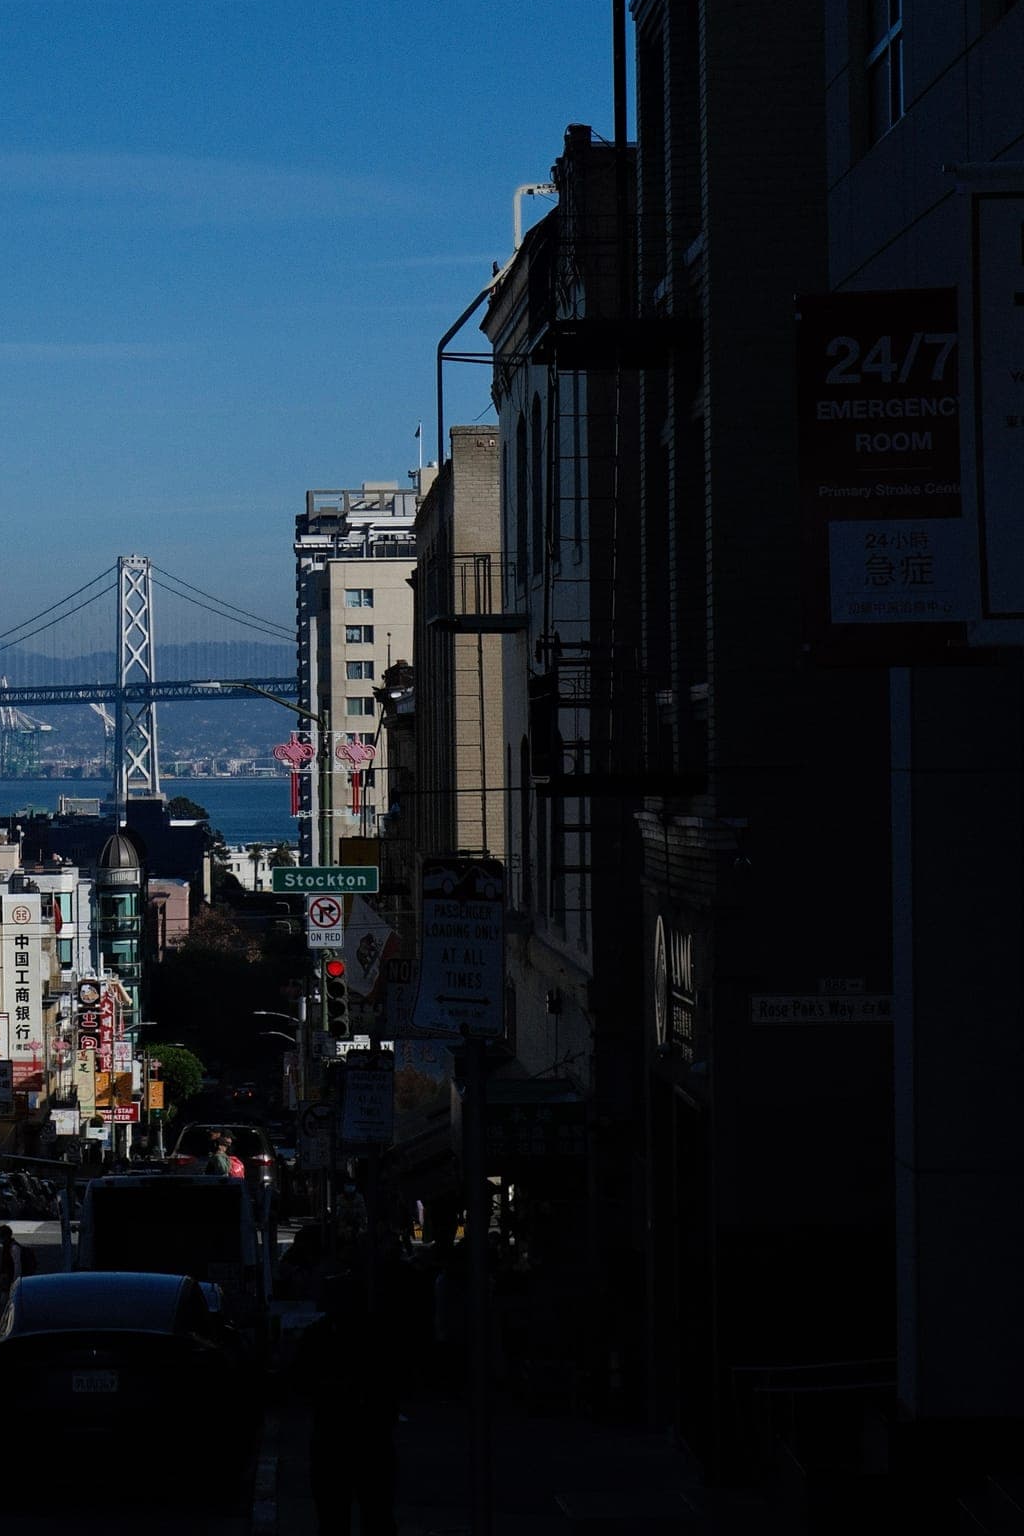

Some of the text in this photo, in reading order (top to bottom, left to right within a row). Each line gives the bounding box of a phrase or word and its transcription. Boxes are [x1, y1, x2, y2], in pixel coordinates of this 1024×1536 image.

[825, 331, 958, 385] 24/7
[816, 397, 960, 421] EMERGENC
[856, 431, 933, 453] ROOM
[818, 485, 872, 499] Primary
[875, 481, 922, 496] Stroke
[865, 553, 934, 586] 急症
[284, 873, 367, 887] Stockton
[433, 902, 495, 921] PASSENGER
[310, 933, 341, 942] ON RED
[425, 922, 500, 941] LOADING ONLY
[441, 947, 487, 966] AT ALL
[14, 934, 31, 1040] 中国工商银行
[447, 971, 483, 989] TIMES
